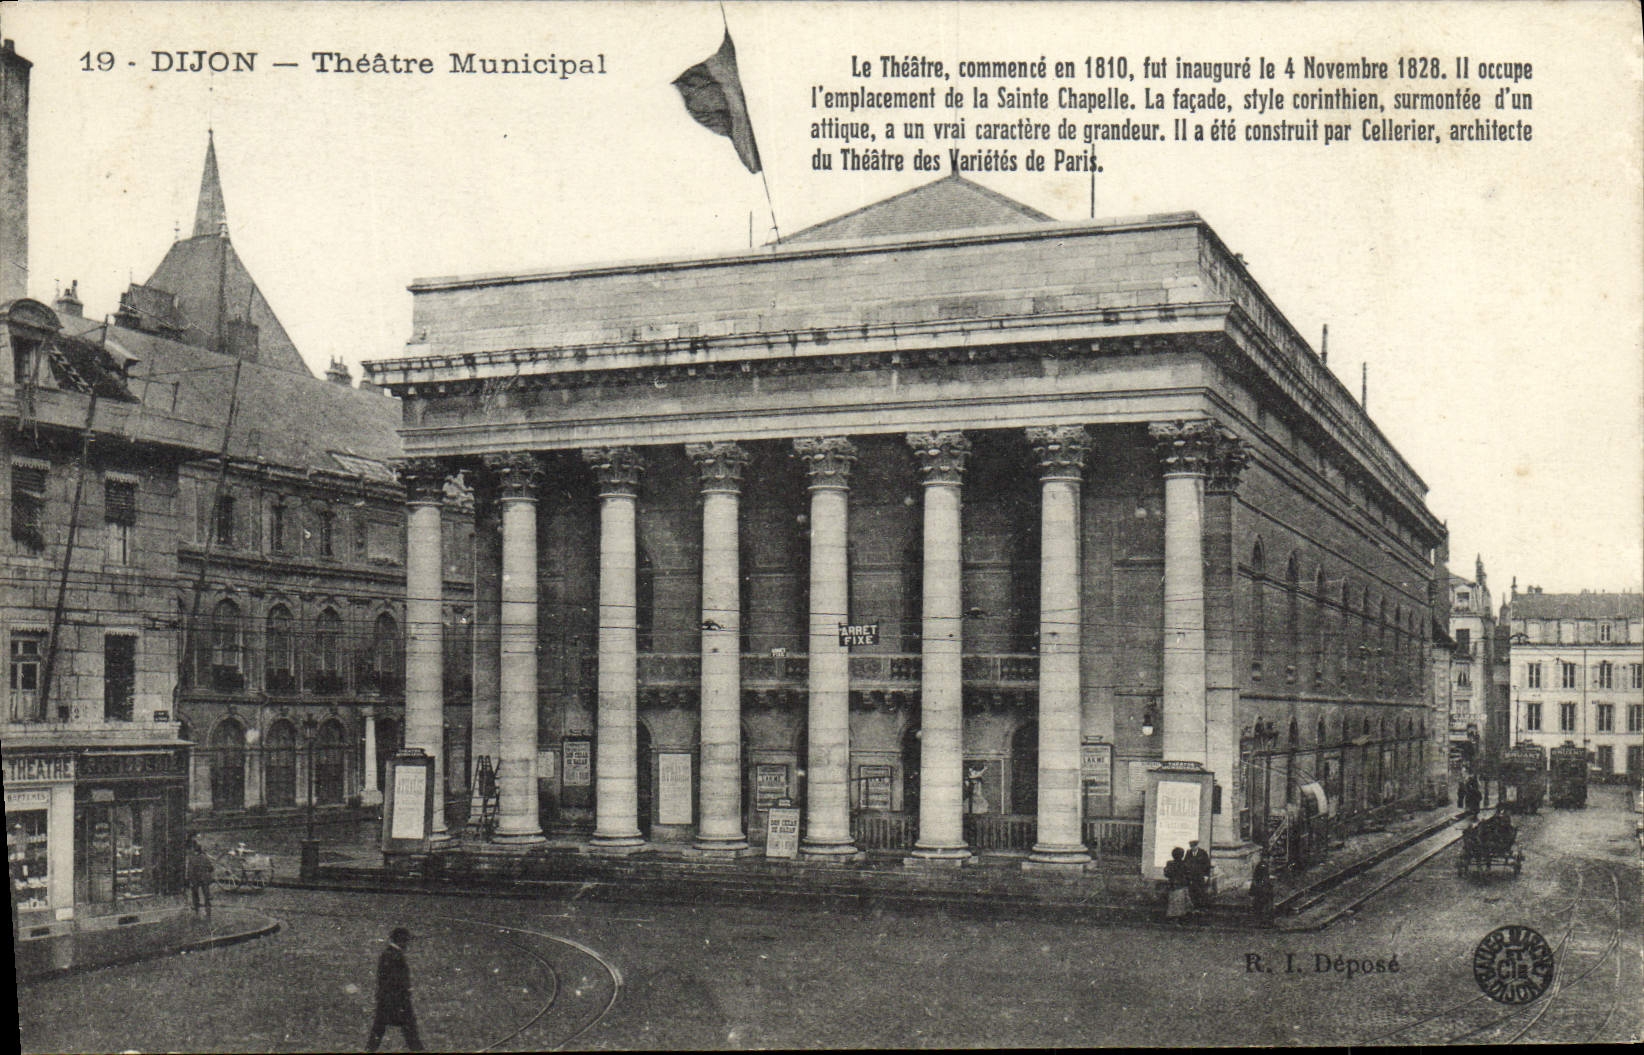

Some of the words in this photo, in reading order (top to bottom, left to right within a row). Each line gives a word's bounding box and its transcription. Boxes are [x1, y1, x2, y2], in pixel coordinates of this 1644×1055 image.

[841, 625, 877, 636] ARRET
[844, 635, 873, 645] FIXE
[8, 758, 72, 781] THEATRE
